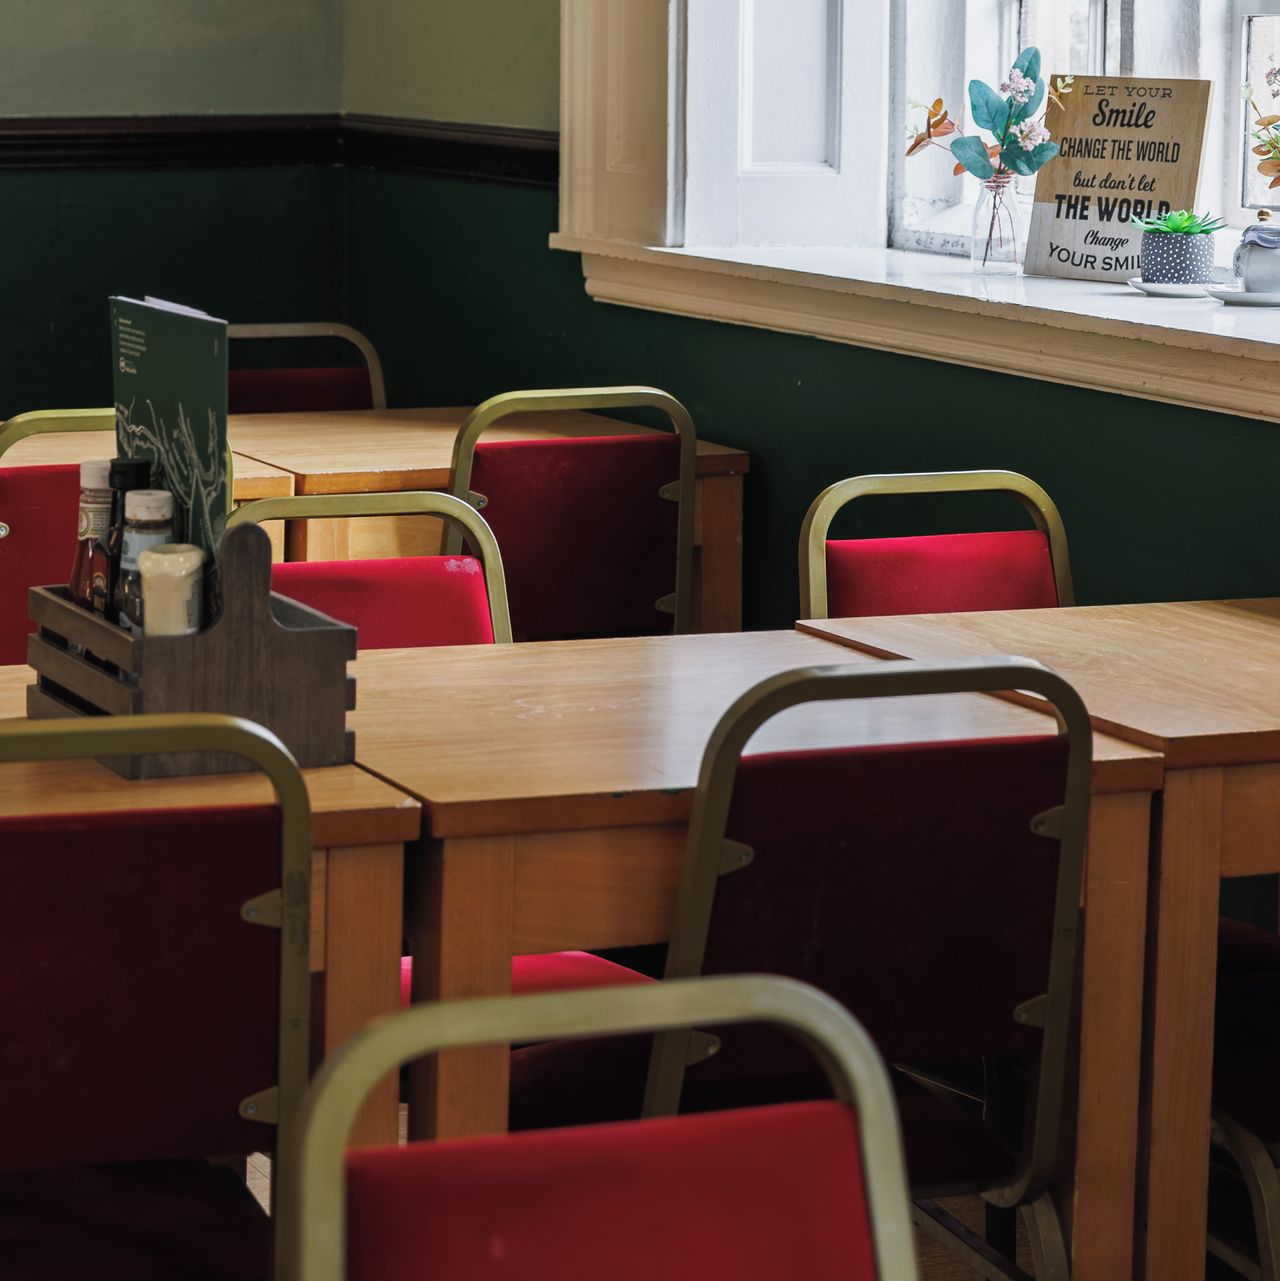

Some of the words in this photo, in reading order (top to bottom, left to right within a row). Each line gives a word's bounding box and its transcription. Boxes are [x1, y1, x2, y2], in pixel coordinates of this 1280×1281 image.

[1083, 85, 1118, 96] LET
[1124, 86, 1173, 98] YOUR
[1092, 99, 1156, 129] Smile
[1060, 137, 1108, 159] CHANGE
[1111, 139, 1133, 160] THE
[1136, 141, 1180, 163] WORLD
[1073, 170, 1096, 188] but
[1099, 172, 1135, 190] don't
[1137, 174, 1156, 192] let
[1055, 194, 1091, 220] THE
[1084, 229, 1129, 251] Change
[1049, 242, 1097, 270] YOUR
[1101, 255, 1141, 271] SMIL
